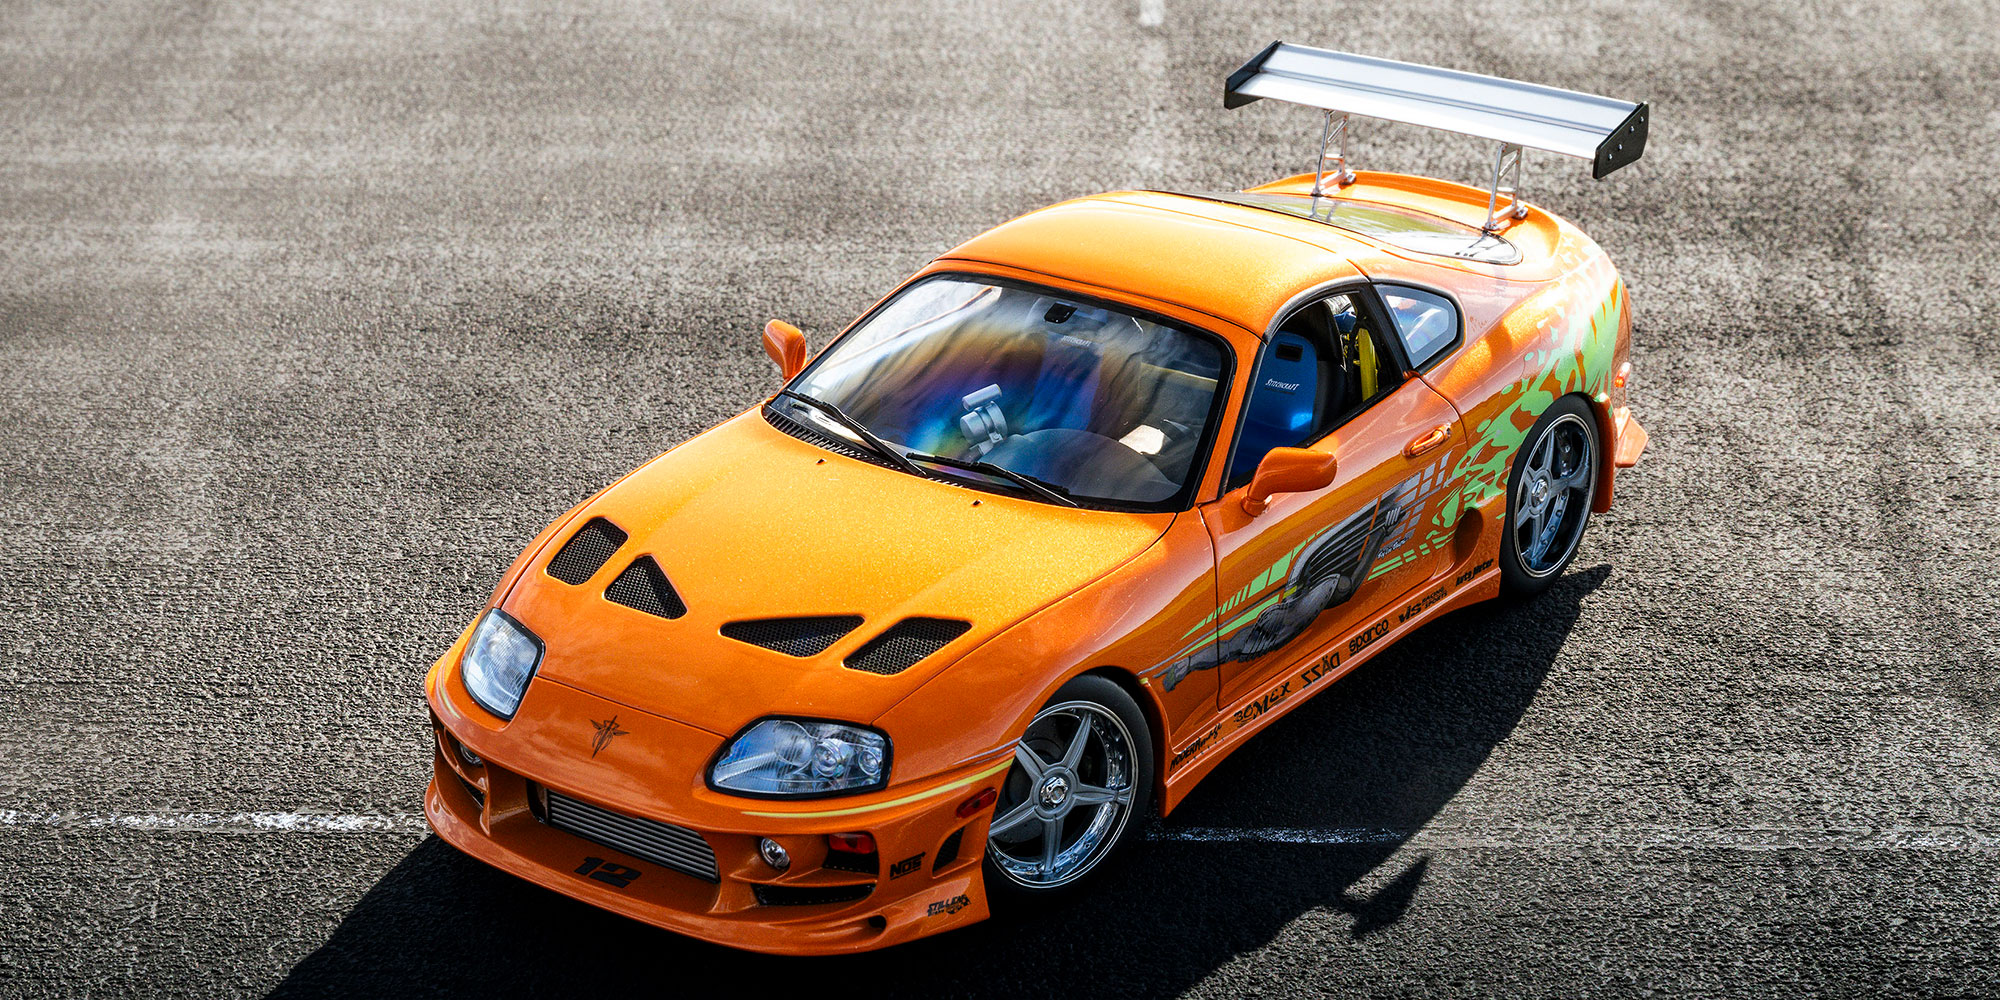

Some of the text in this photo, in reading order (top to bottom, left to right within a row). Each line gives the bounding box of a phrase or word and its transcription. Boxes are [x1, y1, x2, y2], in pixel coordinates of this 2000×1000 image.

[1348, 619, 1389, 654] sparco
[574, 857, 642, 889] 12
[890, 851, 926, 880] NOS
